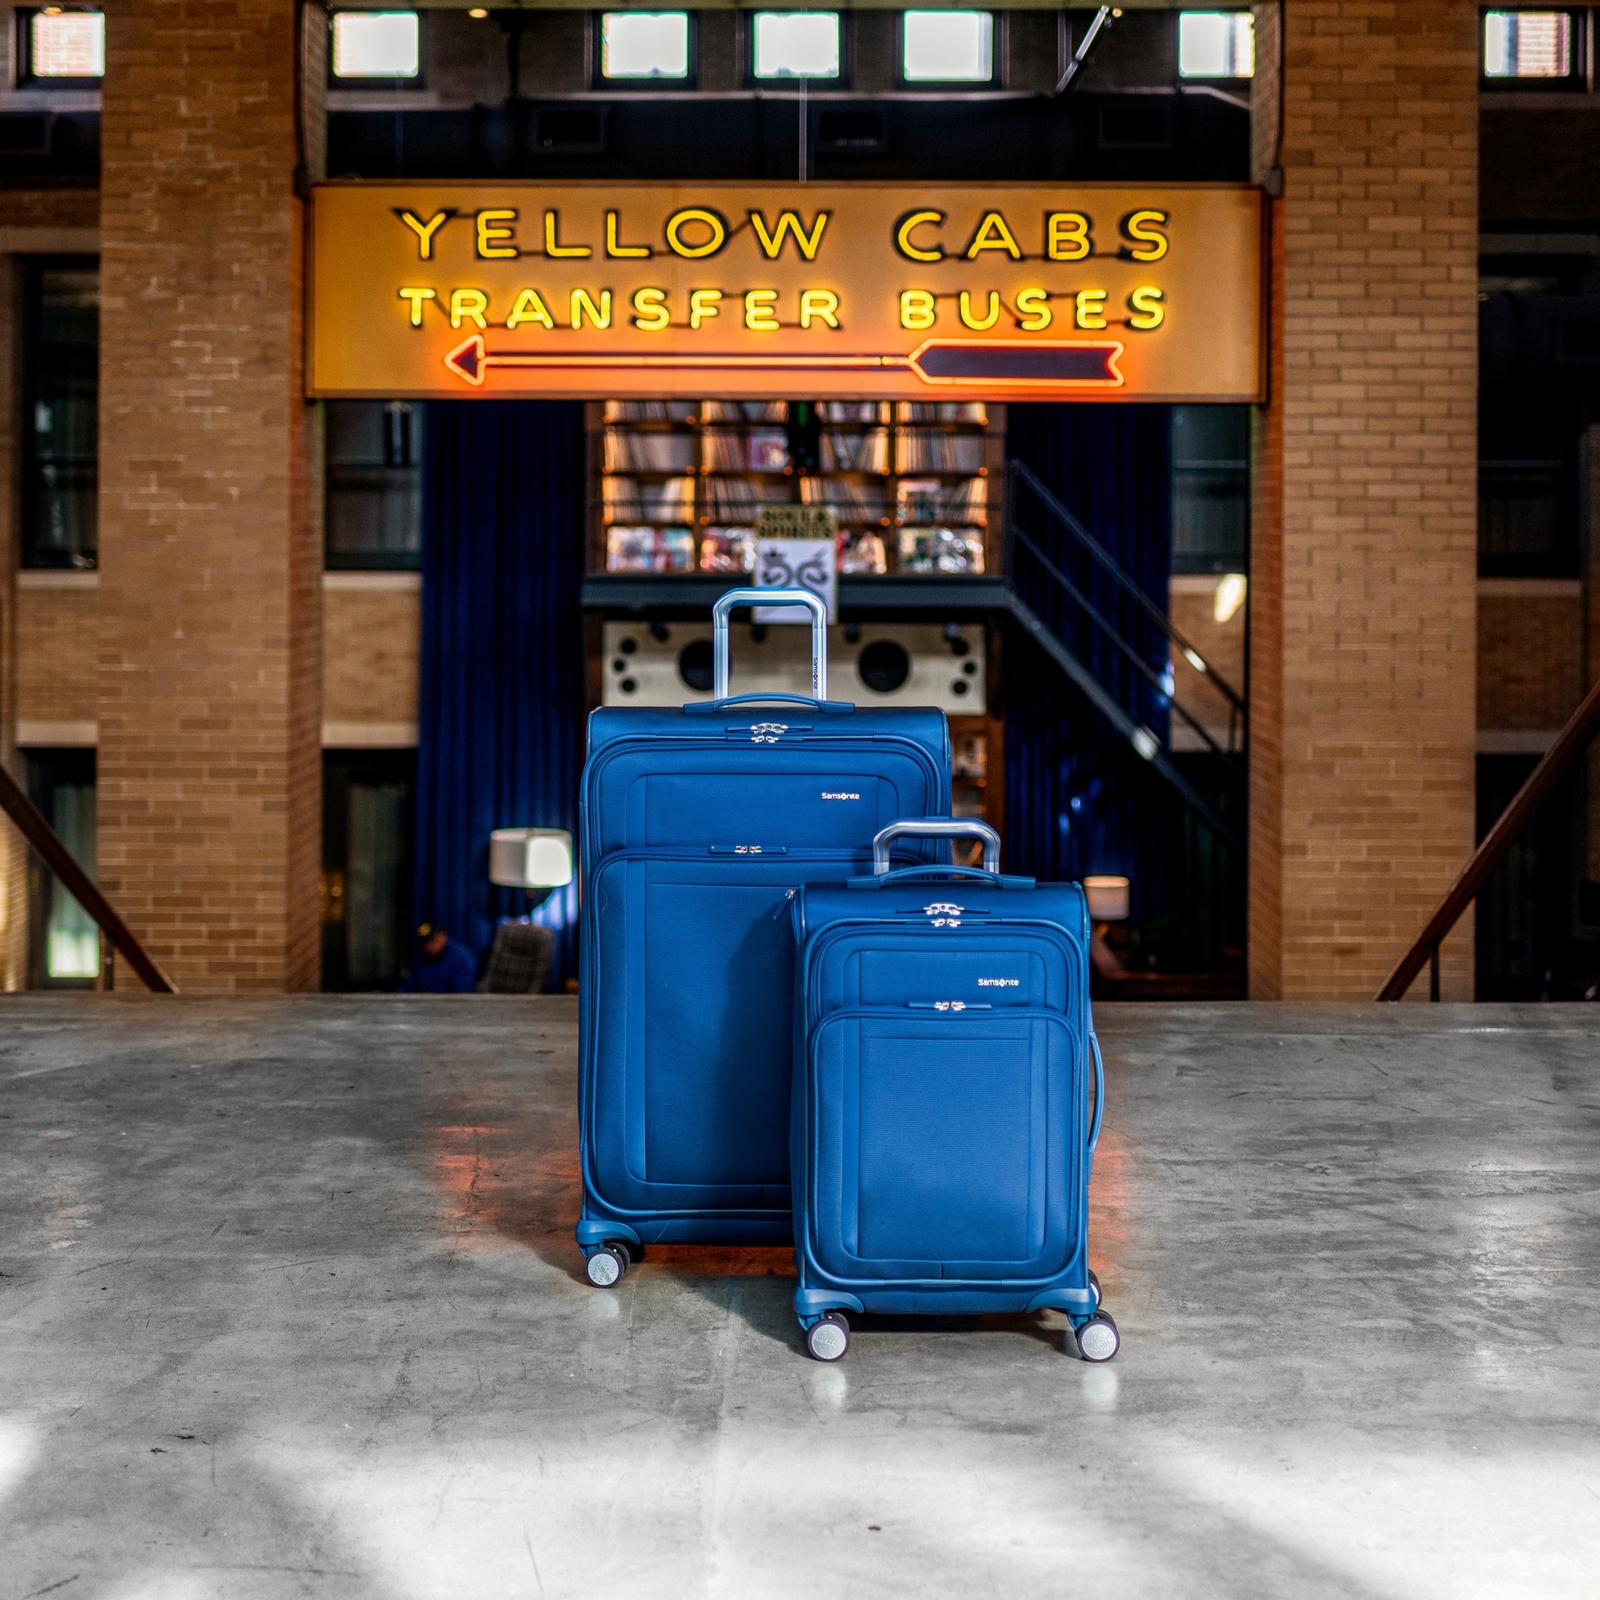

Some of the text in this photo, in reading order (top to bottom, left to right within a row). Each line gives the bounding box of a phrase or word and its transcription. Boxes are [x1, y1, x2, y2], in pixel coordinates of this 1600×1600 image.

[395, 207, 1171, 263] YELLOW CABS
[399, 285, 1166, 331] TRANSFER BUSES
[821, 792, 860, 801] Samsonite
[977, 978, 1020, 988] Samsonite
